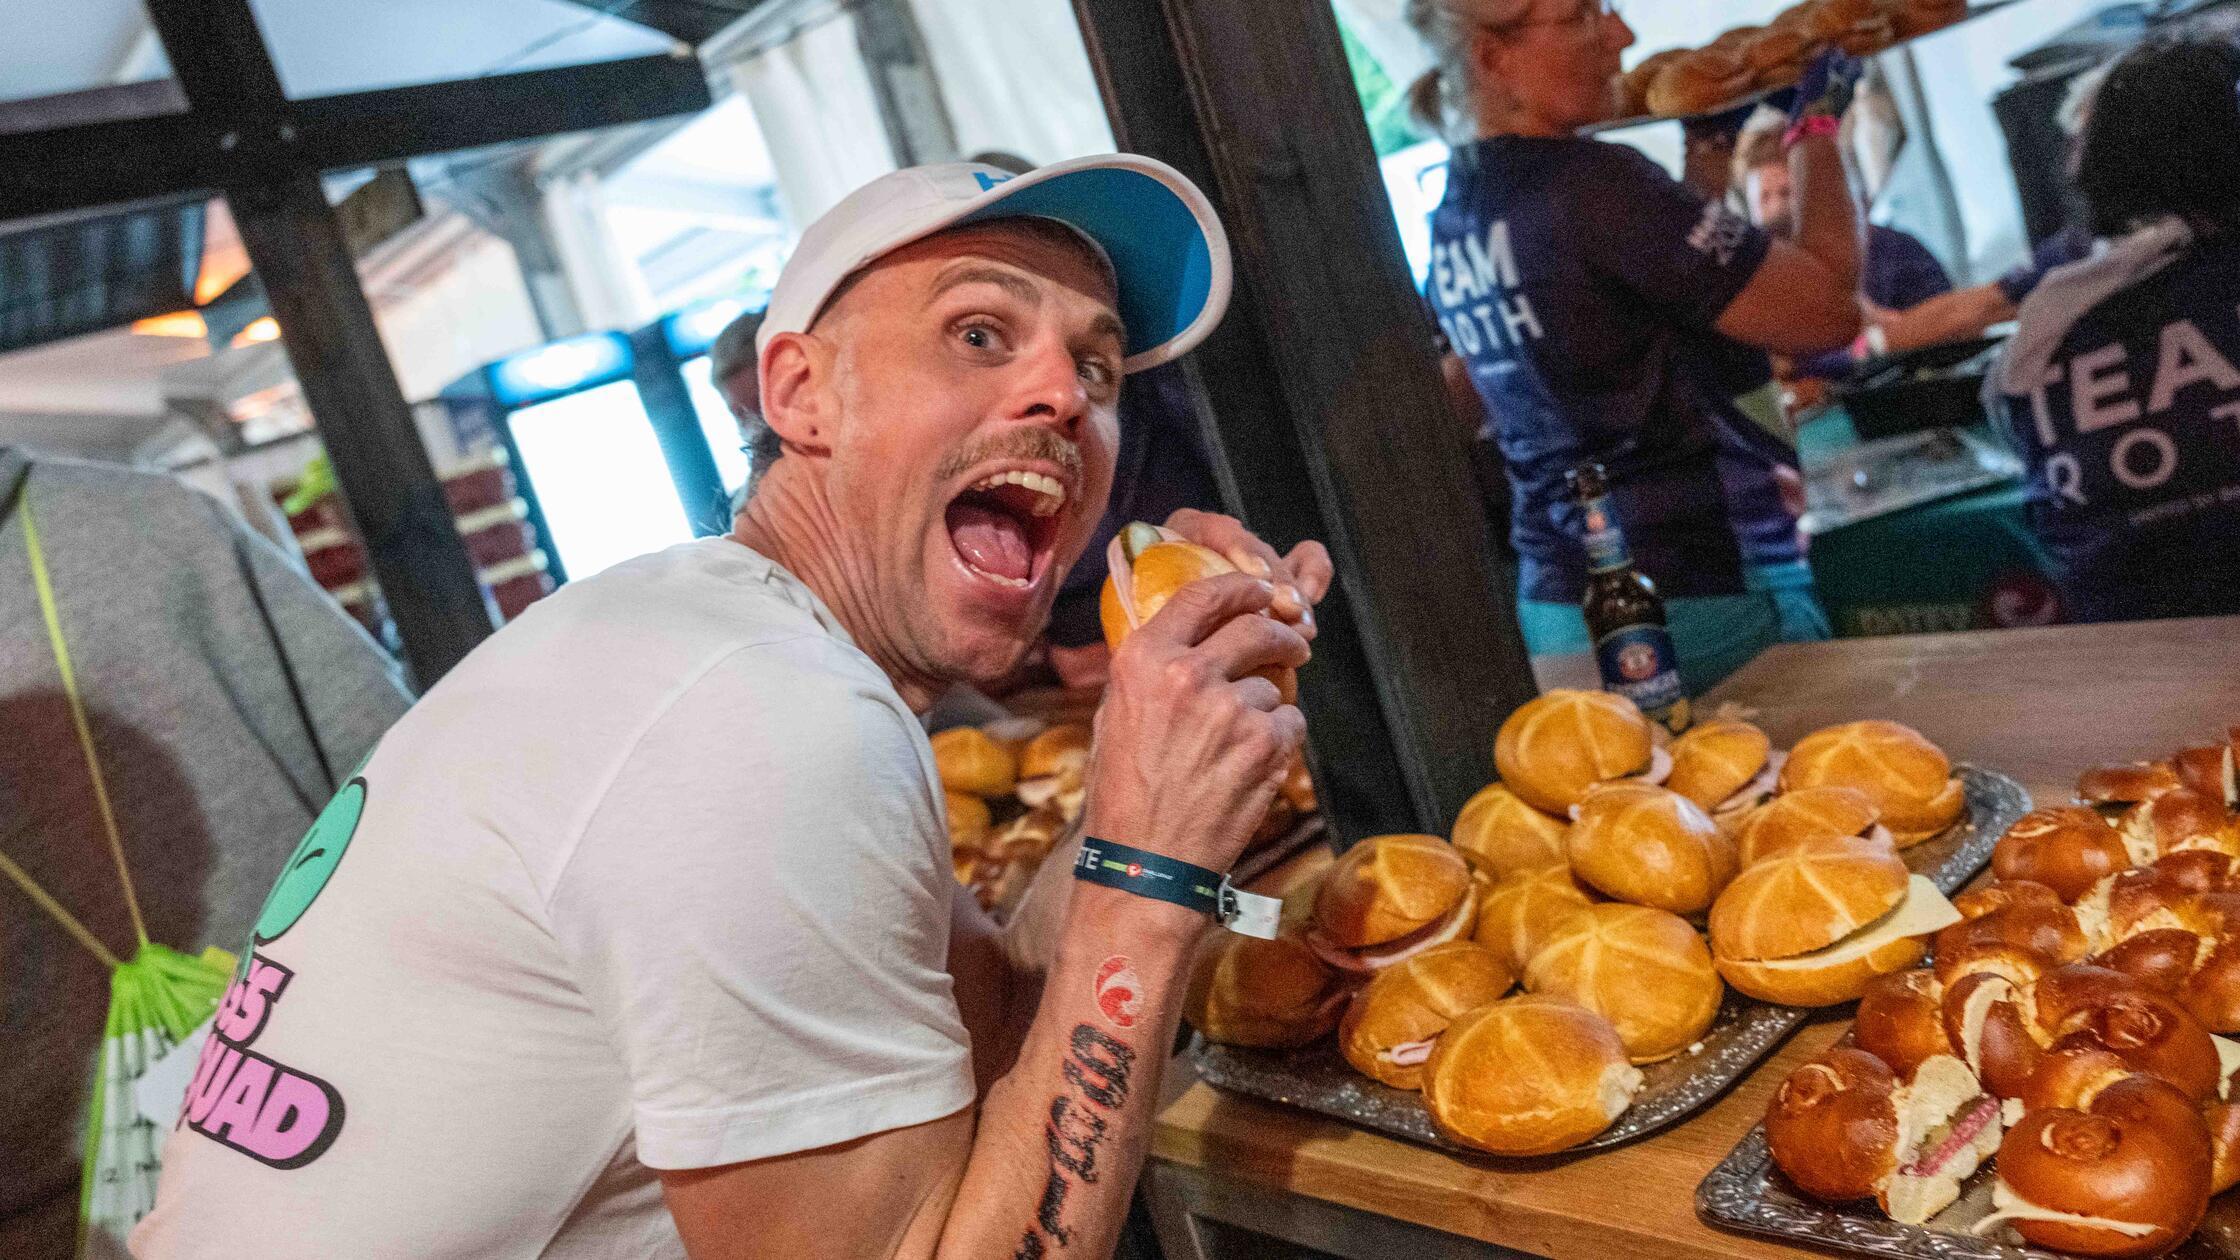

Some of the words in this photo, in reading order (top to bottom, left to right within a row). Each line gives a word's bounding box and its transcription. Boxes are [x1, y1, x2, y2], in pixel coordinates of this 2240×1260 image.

[1434, 221, 1520, 308] EAM
[2029, 319, 2240, 447] TEA
[182, 1034, 346, 1170] UAD
